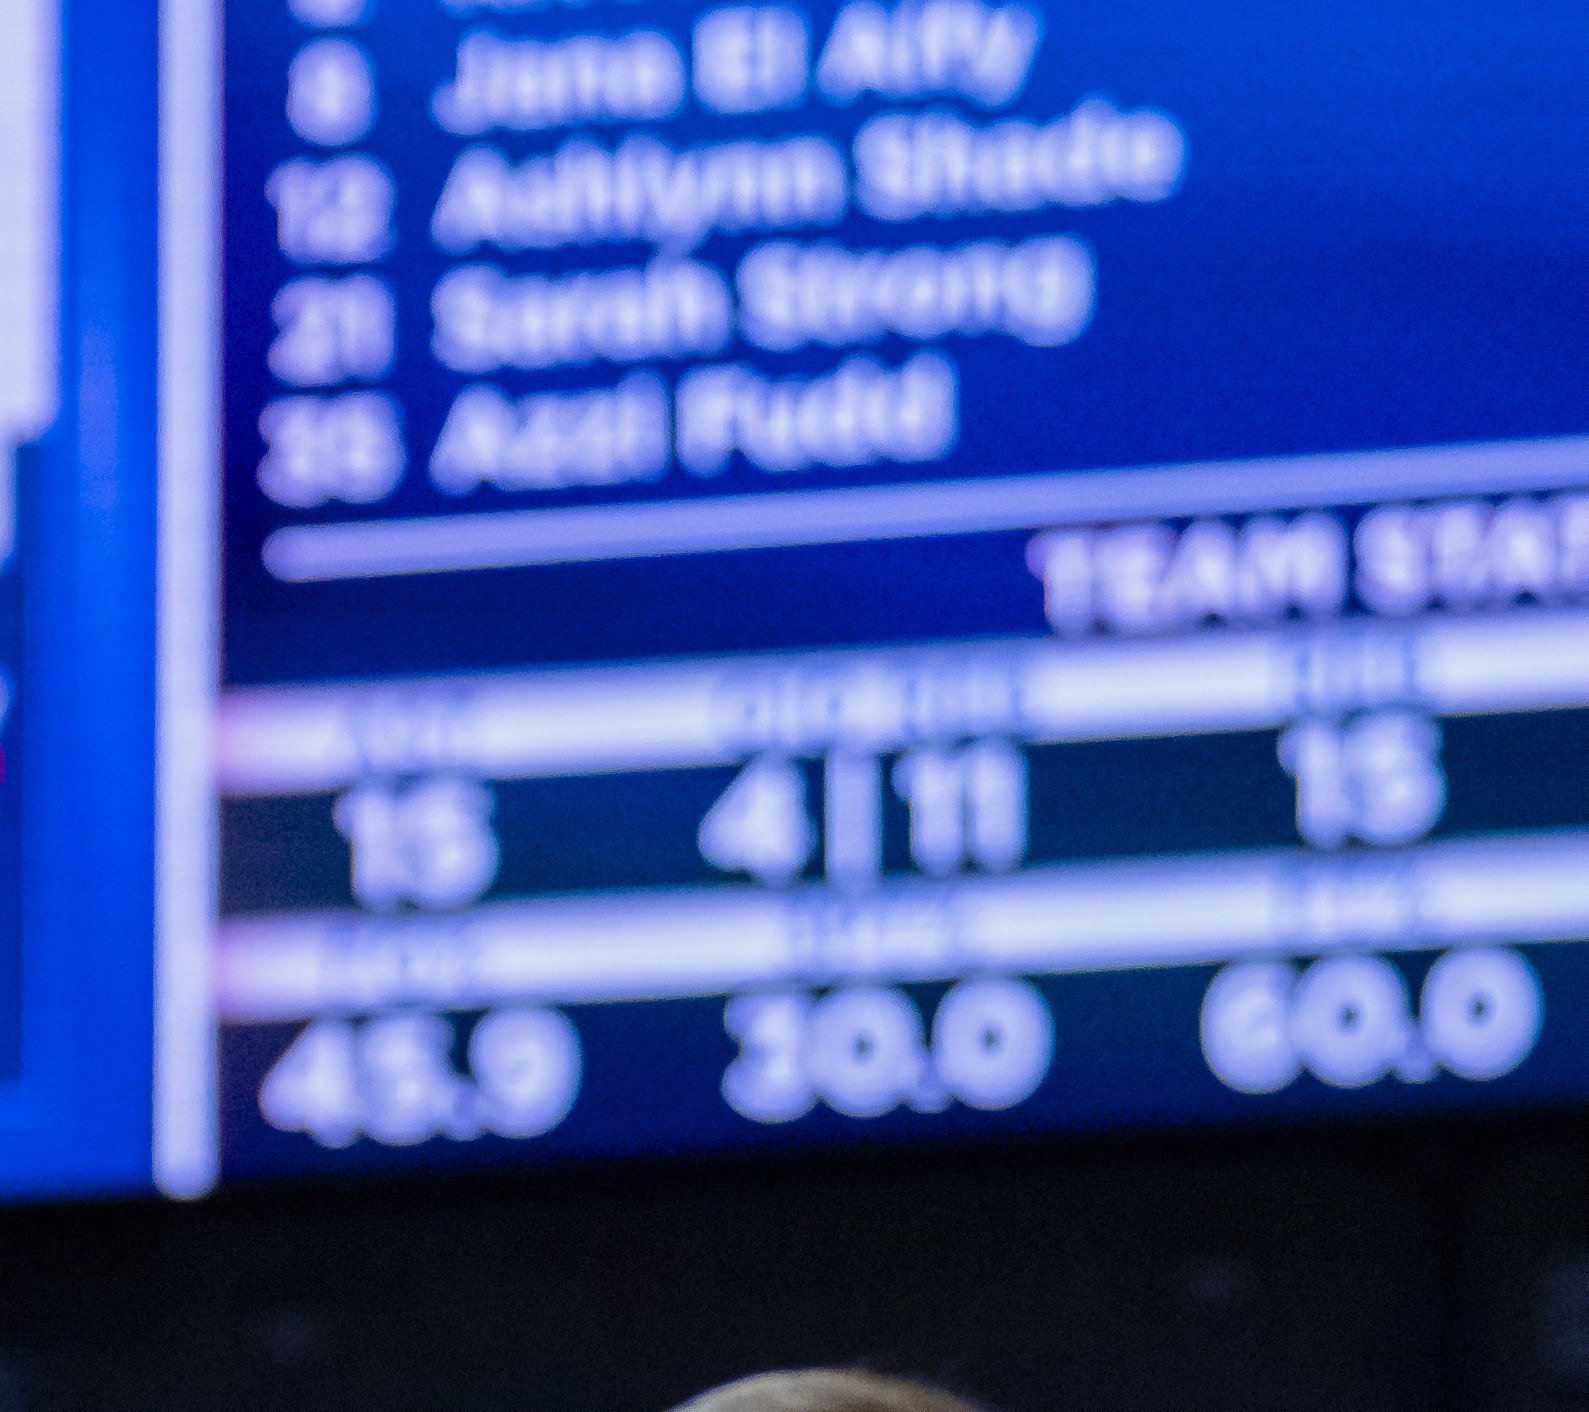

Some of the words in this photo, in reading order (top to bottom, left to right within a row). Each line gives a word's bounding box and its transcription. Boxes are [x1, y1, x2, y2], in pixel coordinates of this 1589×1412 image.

[692, 6, 807, 112] El
[432, 262, 730, 372] Sarah
[738, 234, 1096, 347] Strong
[675, 354, 958, 474] Fudd
[1028, 514, 1346, 634] TEAM
[724, 976, 1053, 1121] 30.0
[1202, 946, 1540, 1093] 60.0
